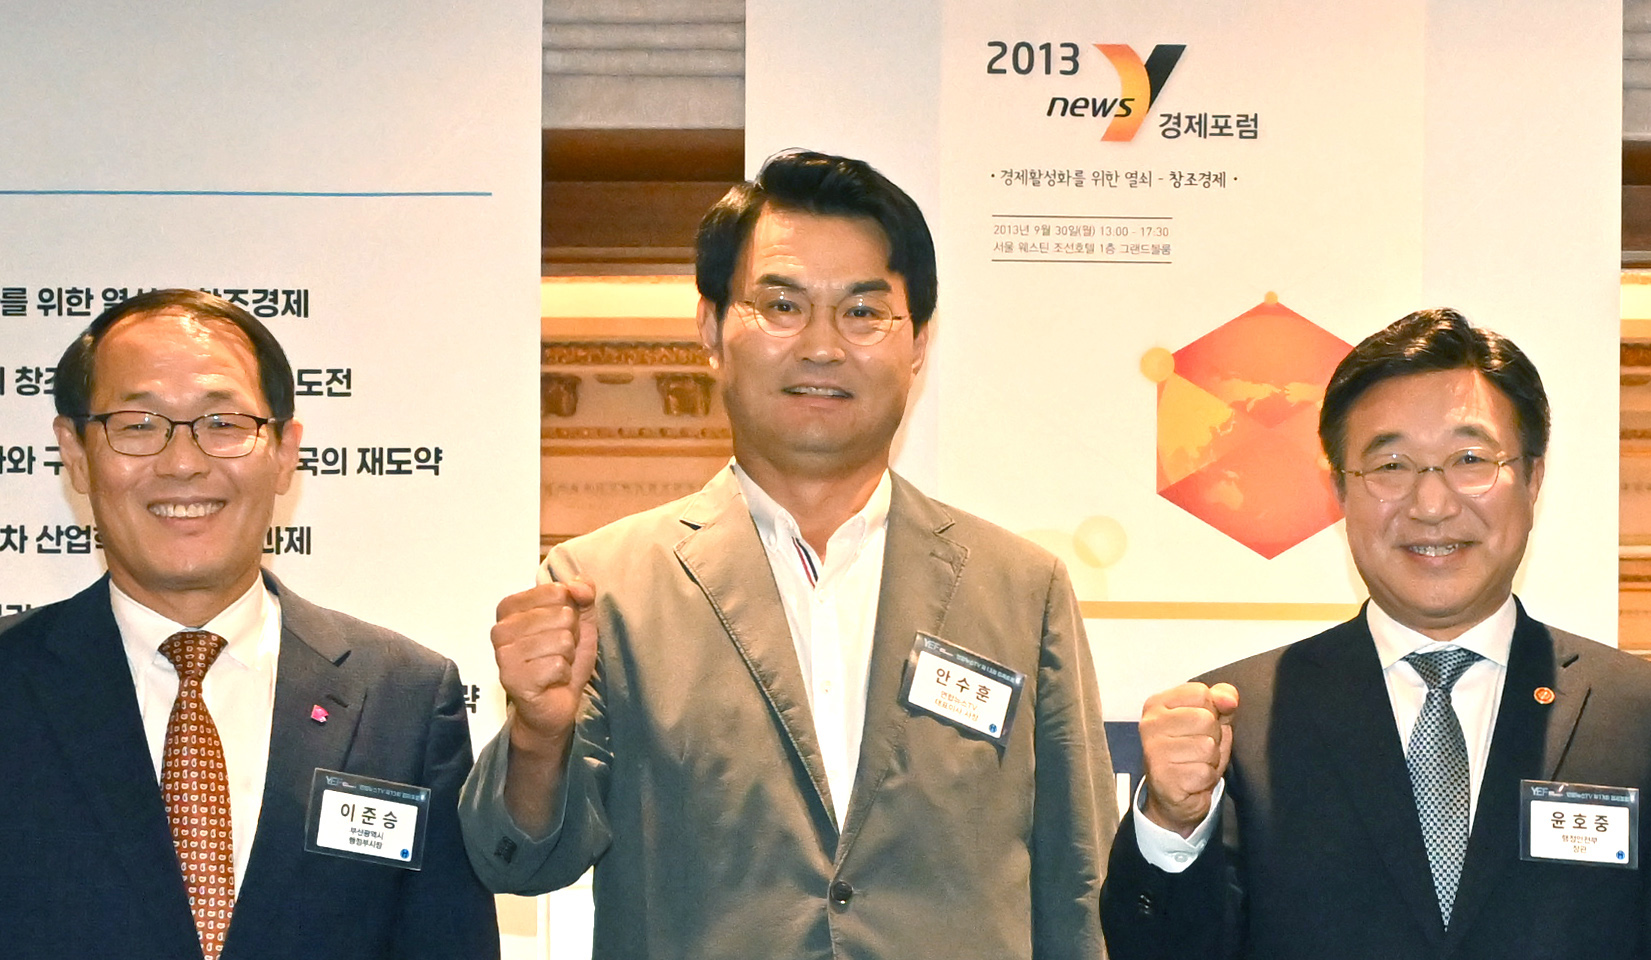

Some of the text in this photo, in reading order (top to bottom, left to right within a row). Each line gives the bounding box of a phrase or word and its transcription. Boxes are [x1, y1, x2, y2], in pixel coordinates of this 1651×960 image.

[987, 40, 1080, 75] 2013
[1046, 96, 1135, 118] news
[1158, 112, 1260, 140] 경제포럼
[1000, 169, 1086, 187] 경제활성화를
[1091, 170, 1120, 188] 위한
[1125, 171, 1153, 188] 열쇠
[1168, 171, 1227, 189] 창조경제
[993, 224, 1030, 236] 2013년
[1034, 224, 1051, 237] 9월
[1055, 225, 1096, 237] 30일(월)
[1100, 226, 1129, 237] 13:00
[1140, 226, 1170, 237] 17:30
[993, 241, 1172, 255] 서울 웨스틴 조선호텔 1층 그랜드볼룸
[37, 287, 94, 316] 위한
[356, 447, 443, 476] 재도약
